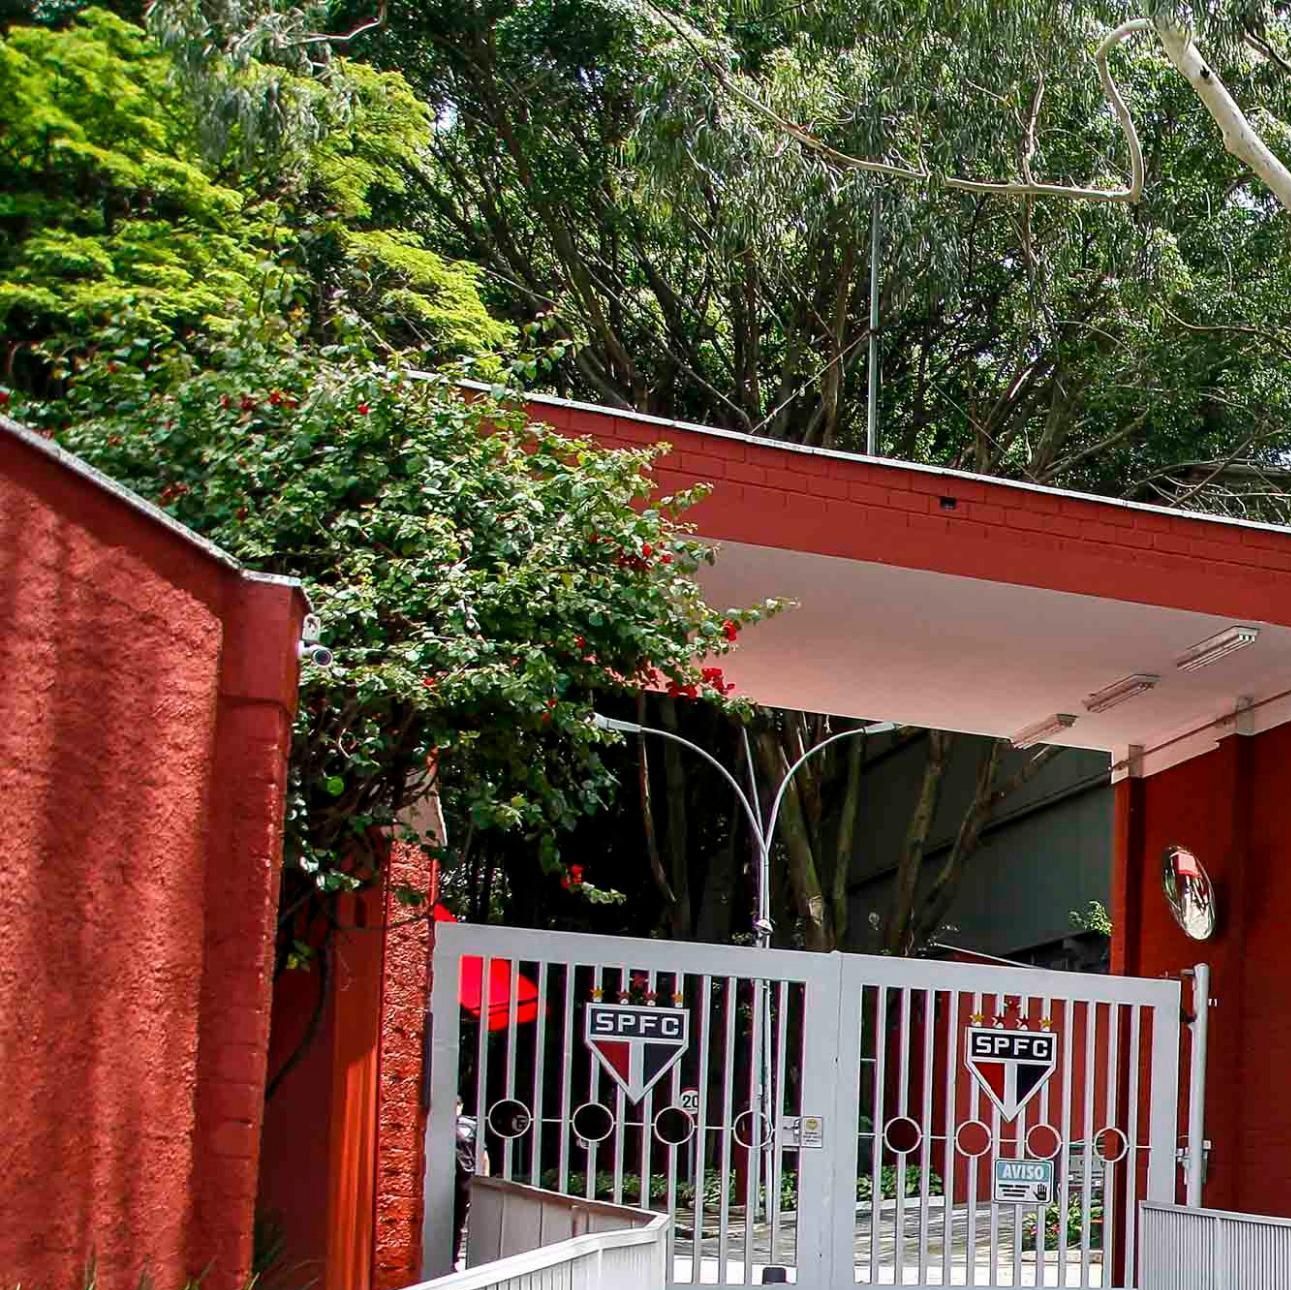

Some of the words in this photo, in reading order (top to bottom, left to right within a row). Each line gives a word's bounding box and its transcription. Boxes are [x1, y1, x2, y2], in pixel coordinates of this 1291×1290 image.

[595, 1012, 679, 1036] SPFC
[975, 1035, 1048, 1057] SPFC
[1001, 1164, 1044, 1180] AVISO
